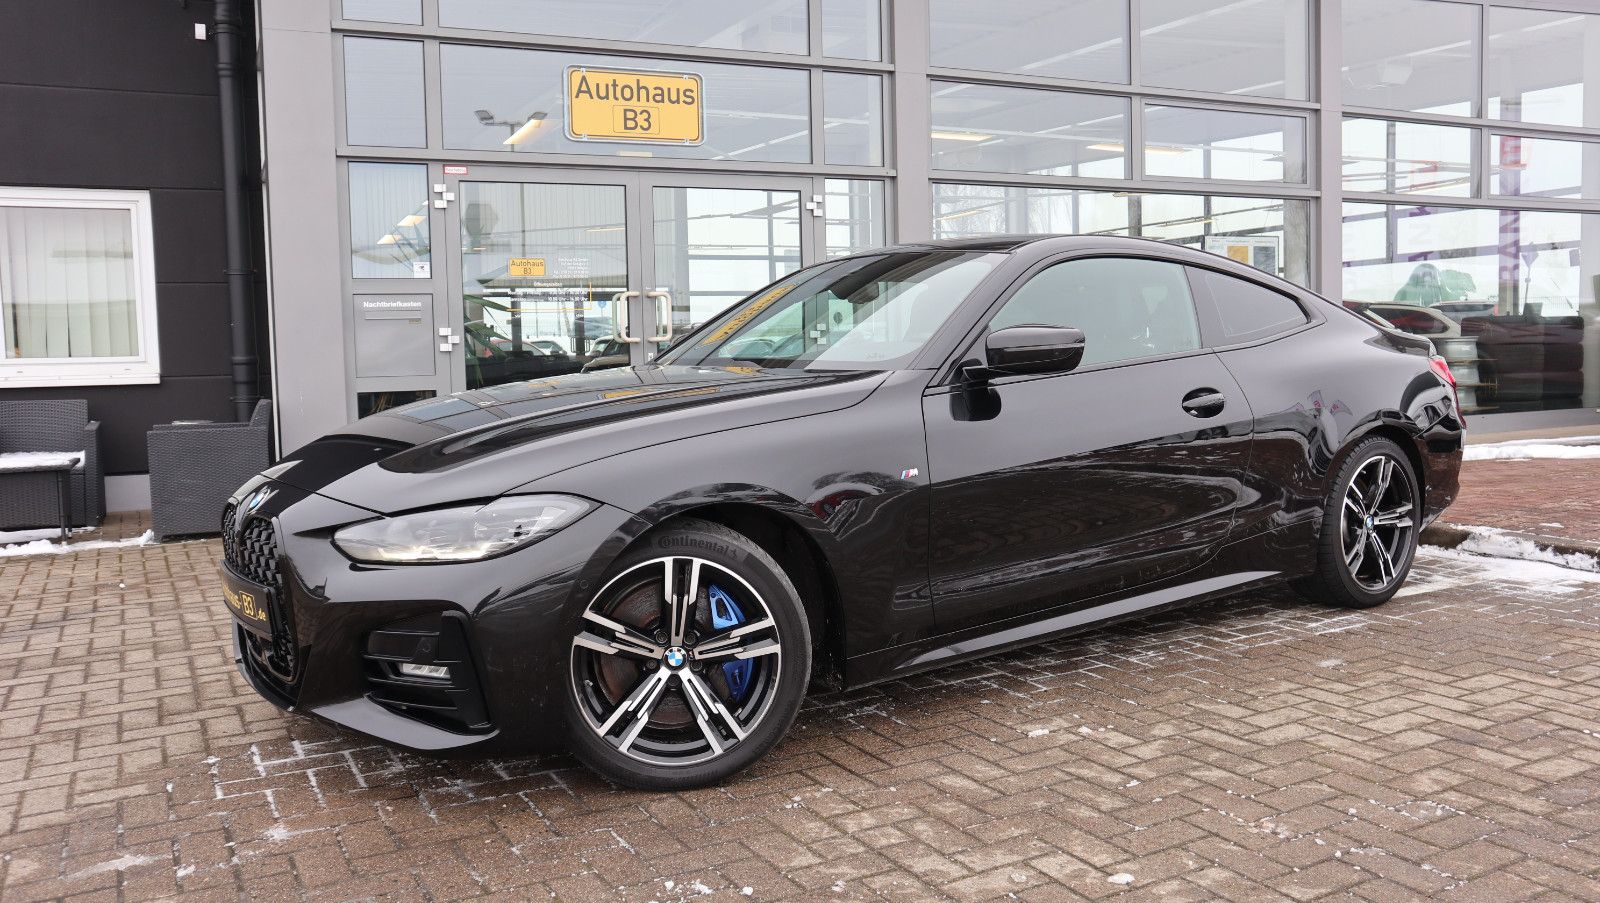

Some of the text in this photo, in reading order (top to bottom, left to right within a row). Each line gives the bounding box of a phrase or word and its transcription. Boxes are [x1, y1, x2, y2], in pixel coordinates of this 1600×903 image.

[575, 75, 696, 105] Autohaus
[623, 108, 652, 131] B3
[523, 267, 532, 275] B3
[363, 301, 422, 309] Nachtbriefkasten
[658, 535, 729, 556] Continental
